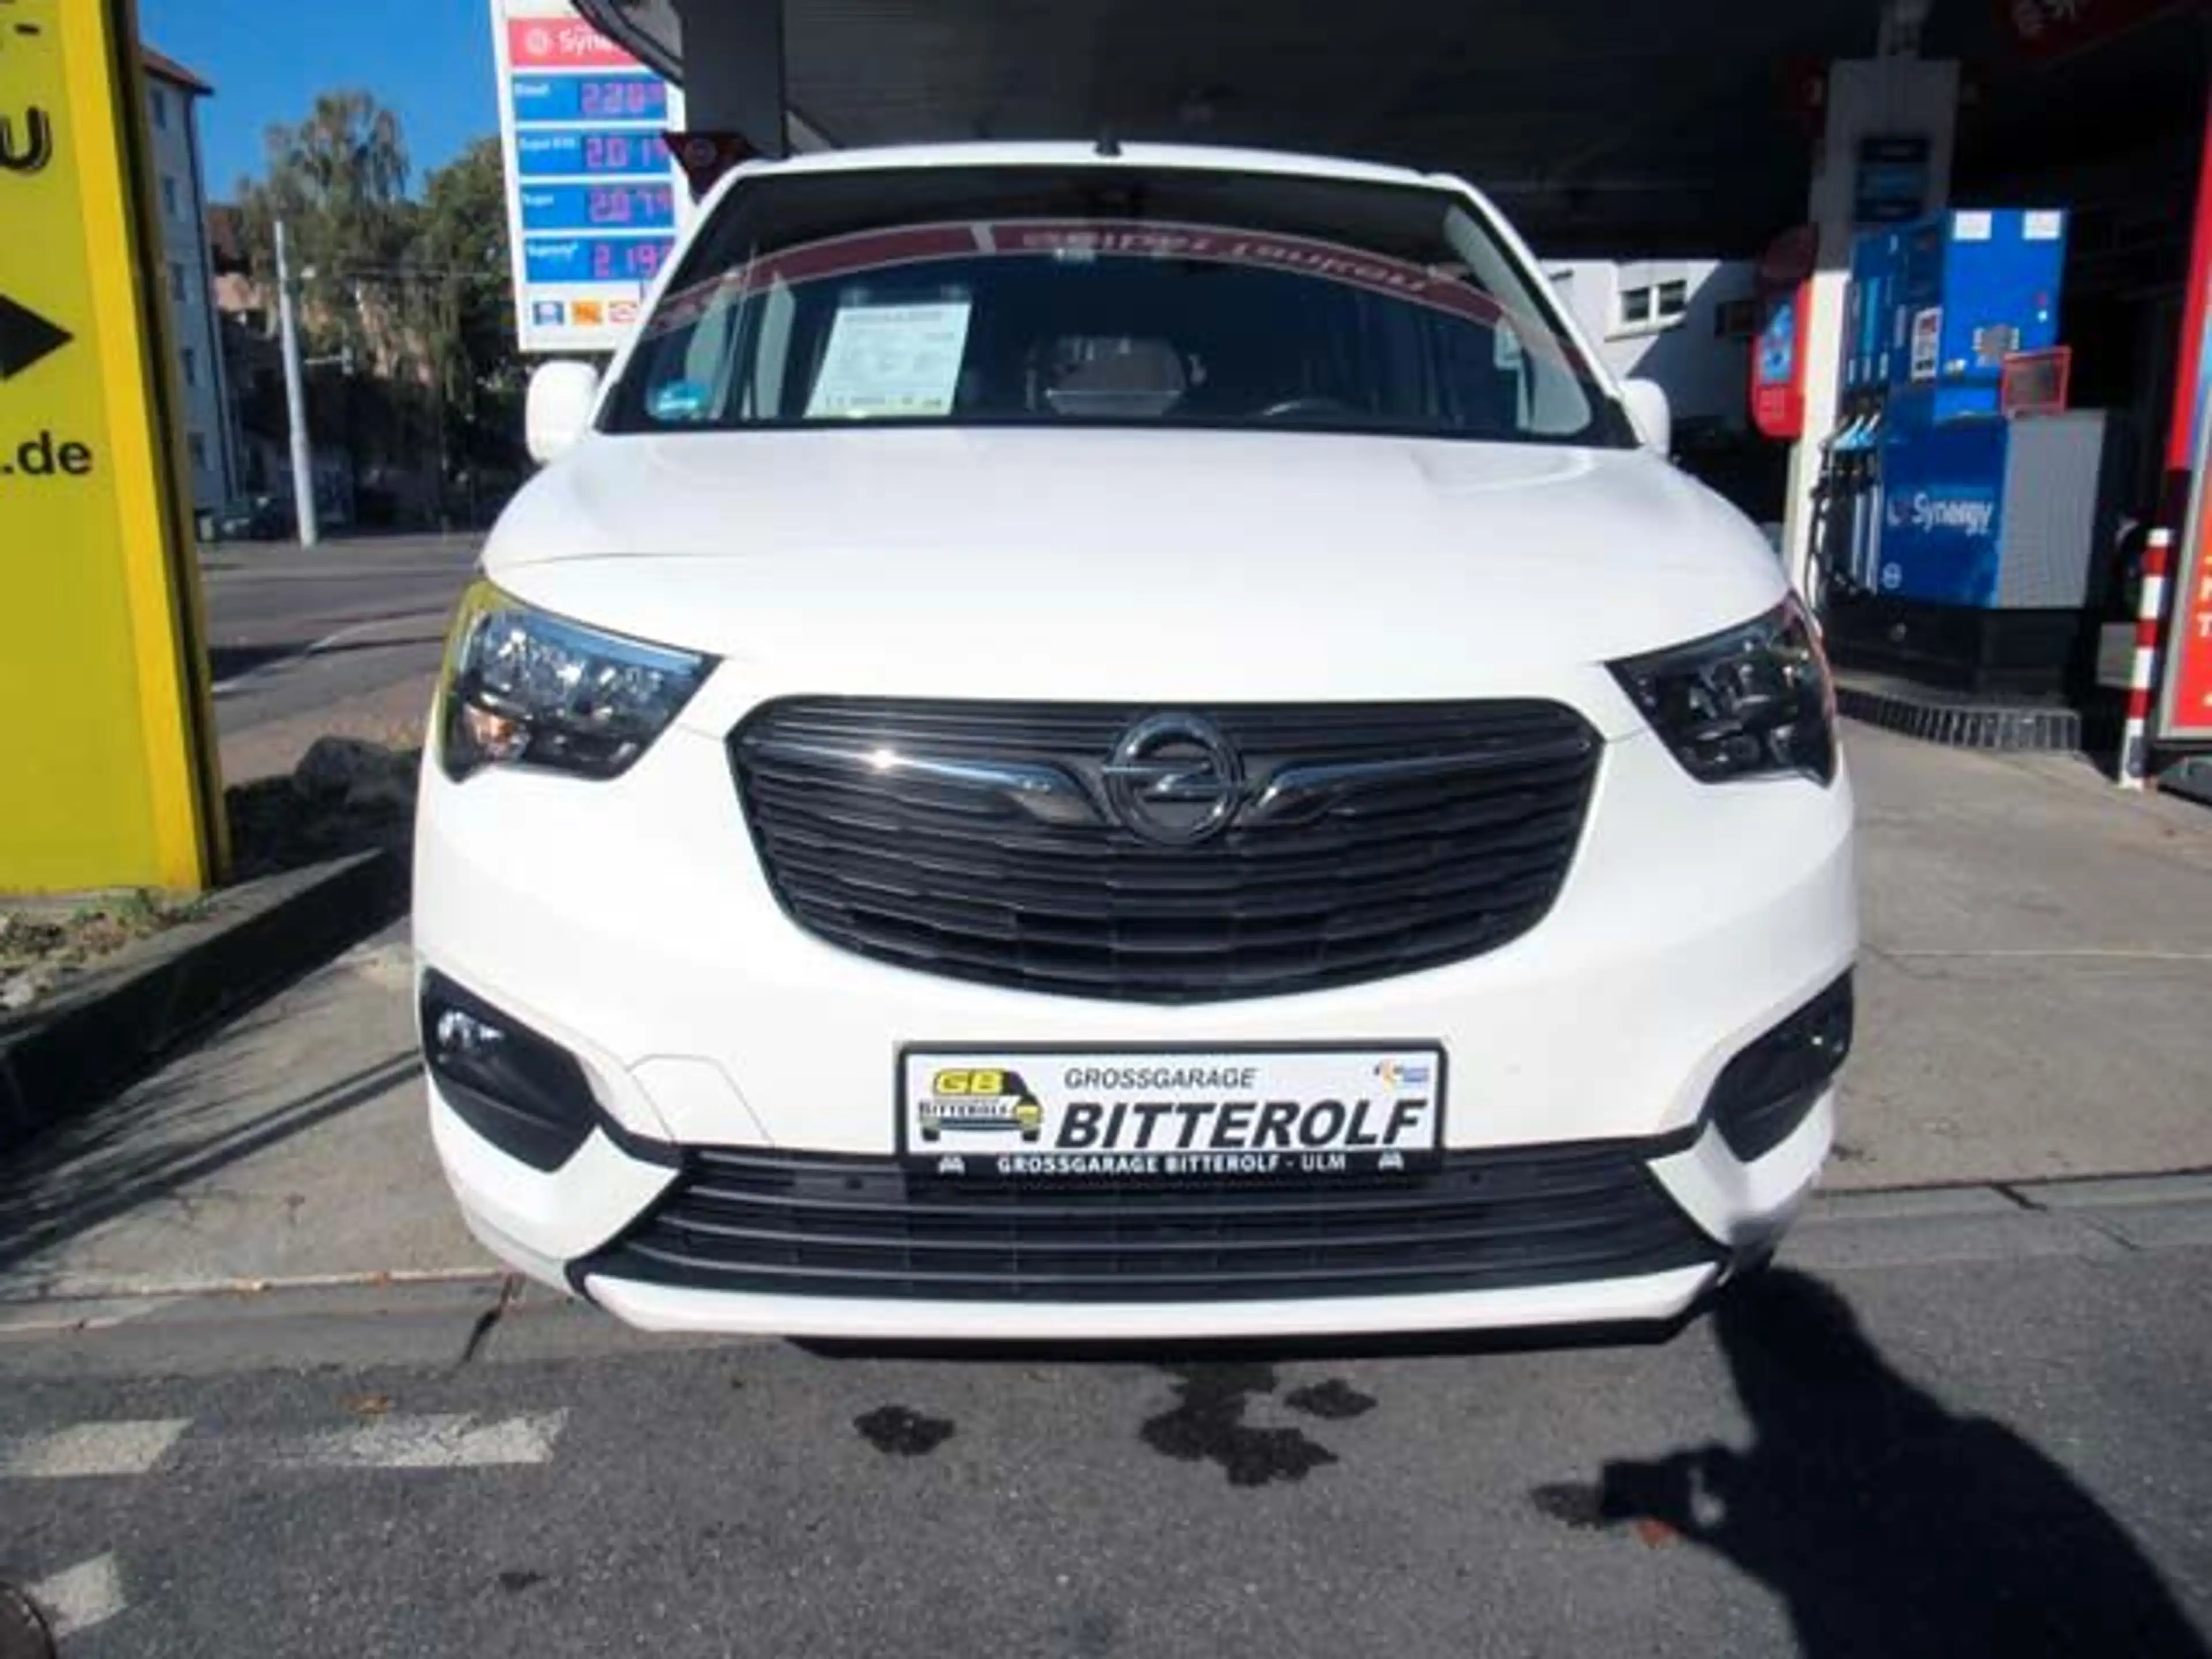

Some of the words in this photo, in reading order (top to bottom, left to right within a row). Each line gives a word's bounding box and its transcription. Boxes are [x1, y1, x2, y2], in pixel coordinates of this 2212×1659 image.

[1911, 491, 1994, 536] Synergy
[1064, 1068, 1257, 1089] GROSSGARAGE
[1055, 1099, 1427, 1149] BITTEROLF
[997, 1154, 1157, 1173] GROSSGARAGE
[1165, 1153, 1280, 1173] BITTEROLF
[1301, 1153, 1347, 1172] ULM
